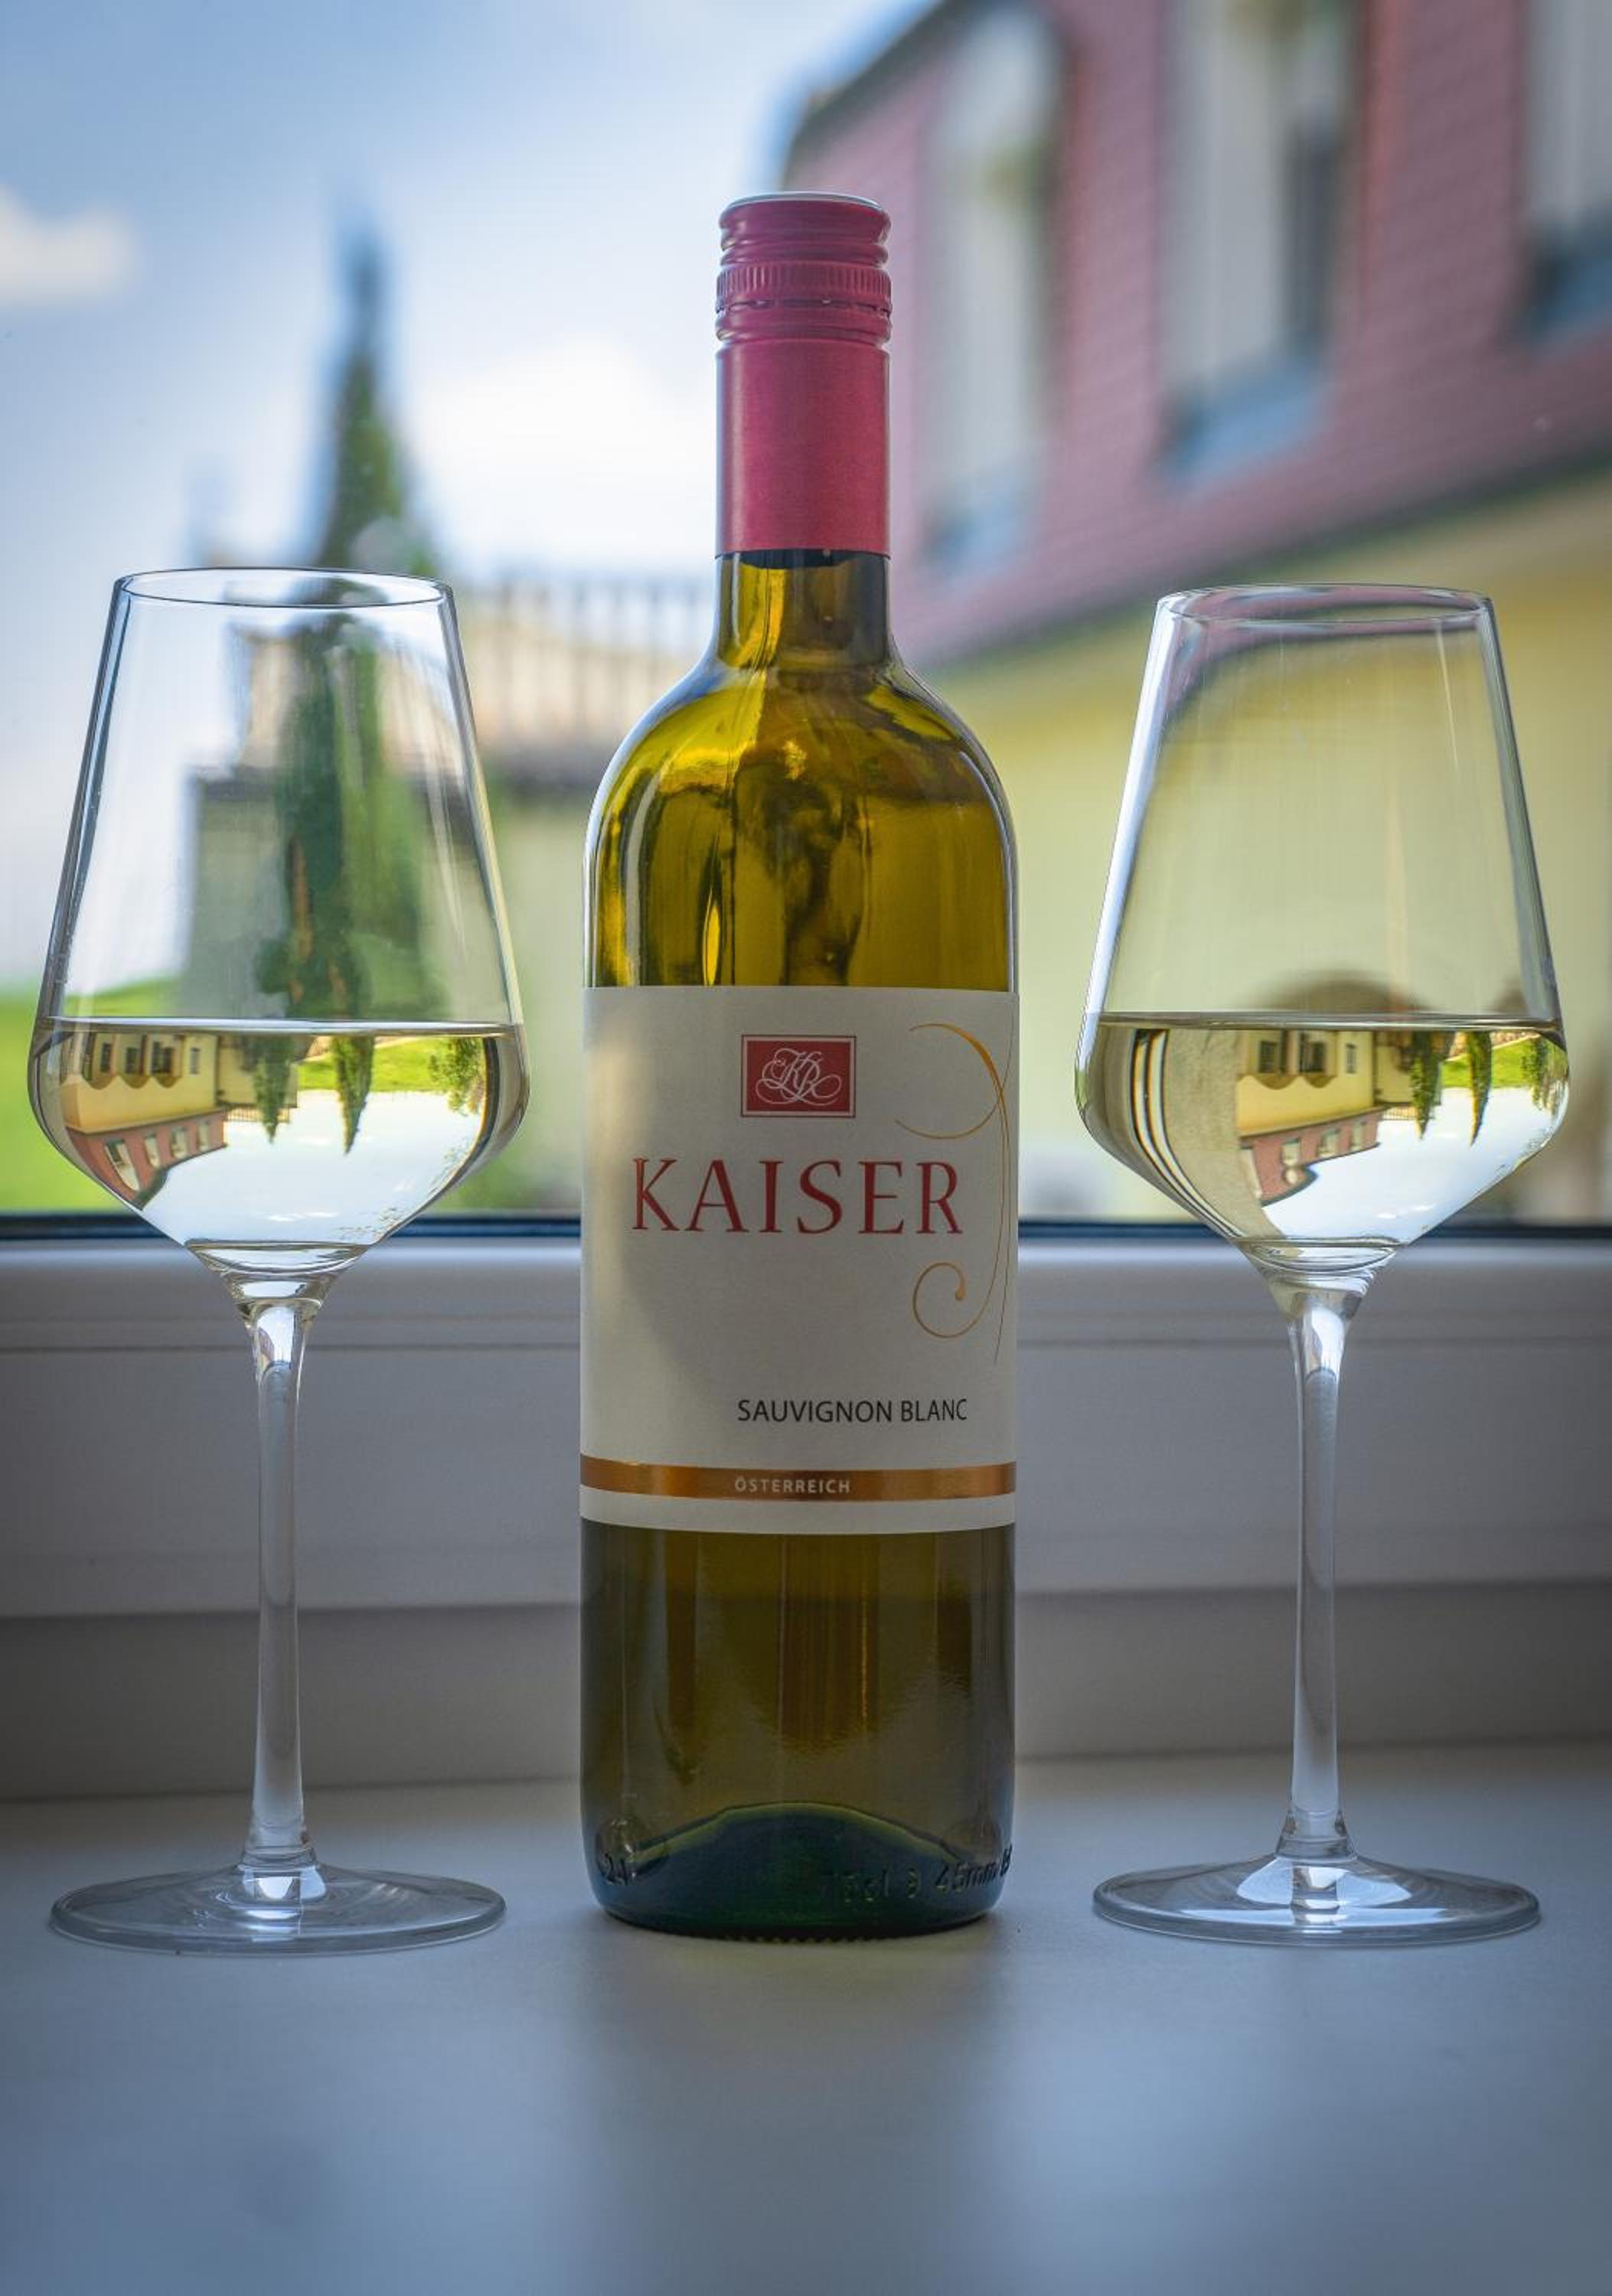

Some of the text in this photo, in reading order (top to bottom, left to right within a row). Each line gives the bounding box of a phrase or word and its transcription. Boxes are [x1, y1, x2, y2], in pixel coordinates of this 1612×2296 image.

[631, 1157, 963, 1235] KAISER
[737, 1398, 968, 1423] SAUVIGNON BLANC
[734, 1476, 850, 1493] ÖSTERREICH
